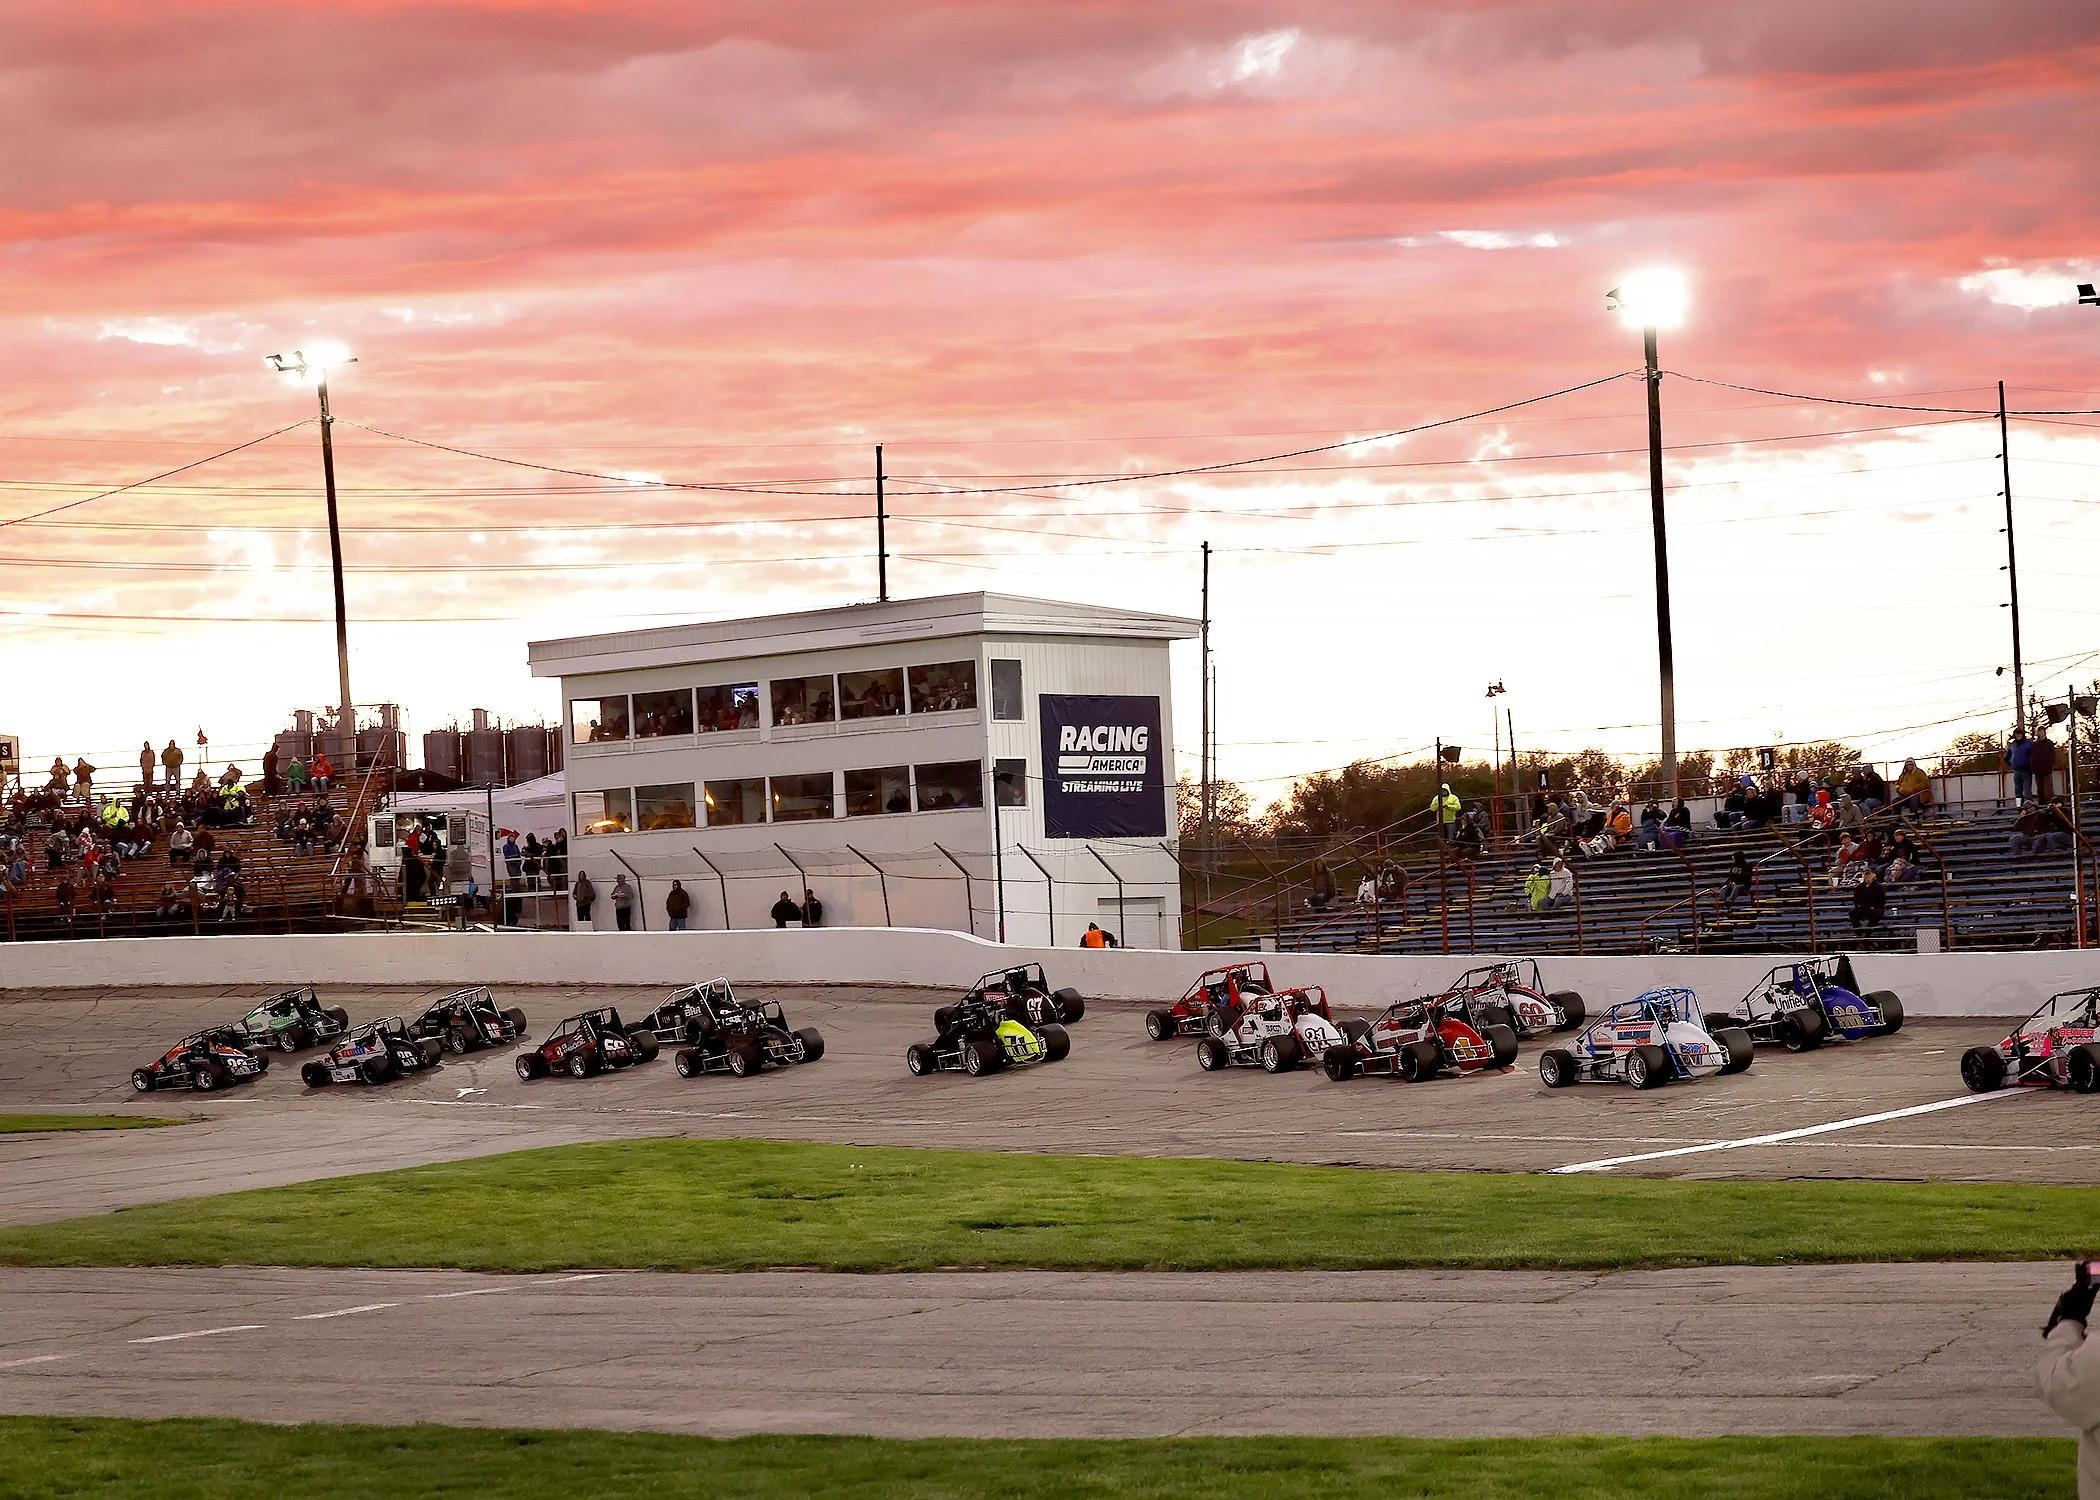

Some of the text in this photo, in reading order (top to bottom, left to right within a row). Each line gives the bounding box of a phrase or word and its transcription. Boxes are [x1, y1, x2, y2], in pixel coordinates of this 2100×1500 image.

[1059, 725, 1149, 752] RACING
[1, 745, 8, 756] S
[1061, 780, 1143, 793] STREAMING LIVE
[1541, 774, 1547, 787] A
[1774, 996, 1806, 1011] Unified
[2059, 1028, 2094, 1037] BEAVER
